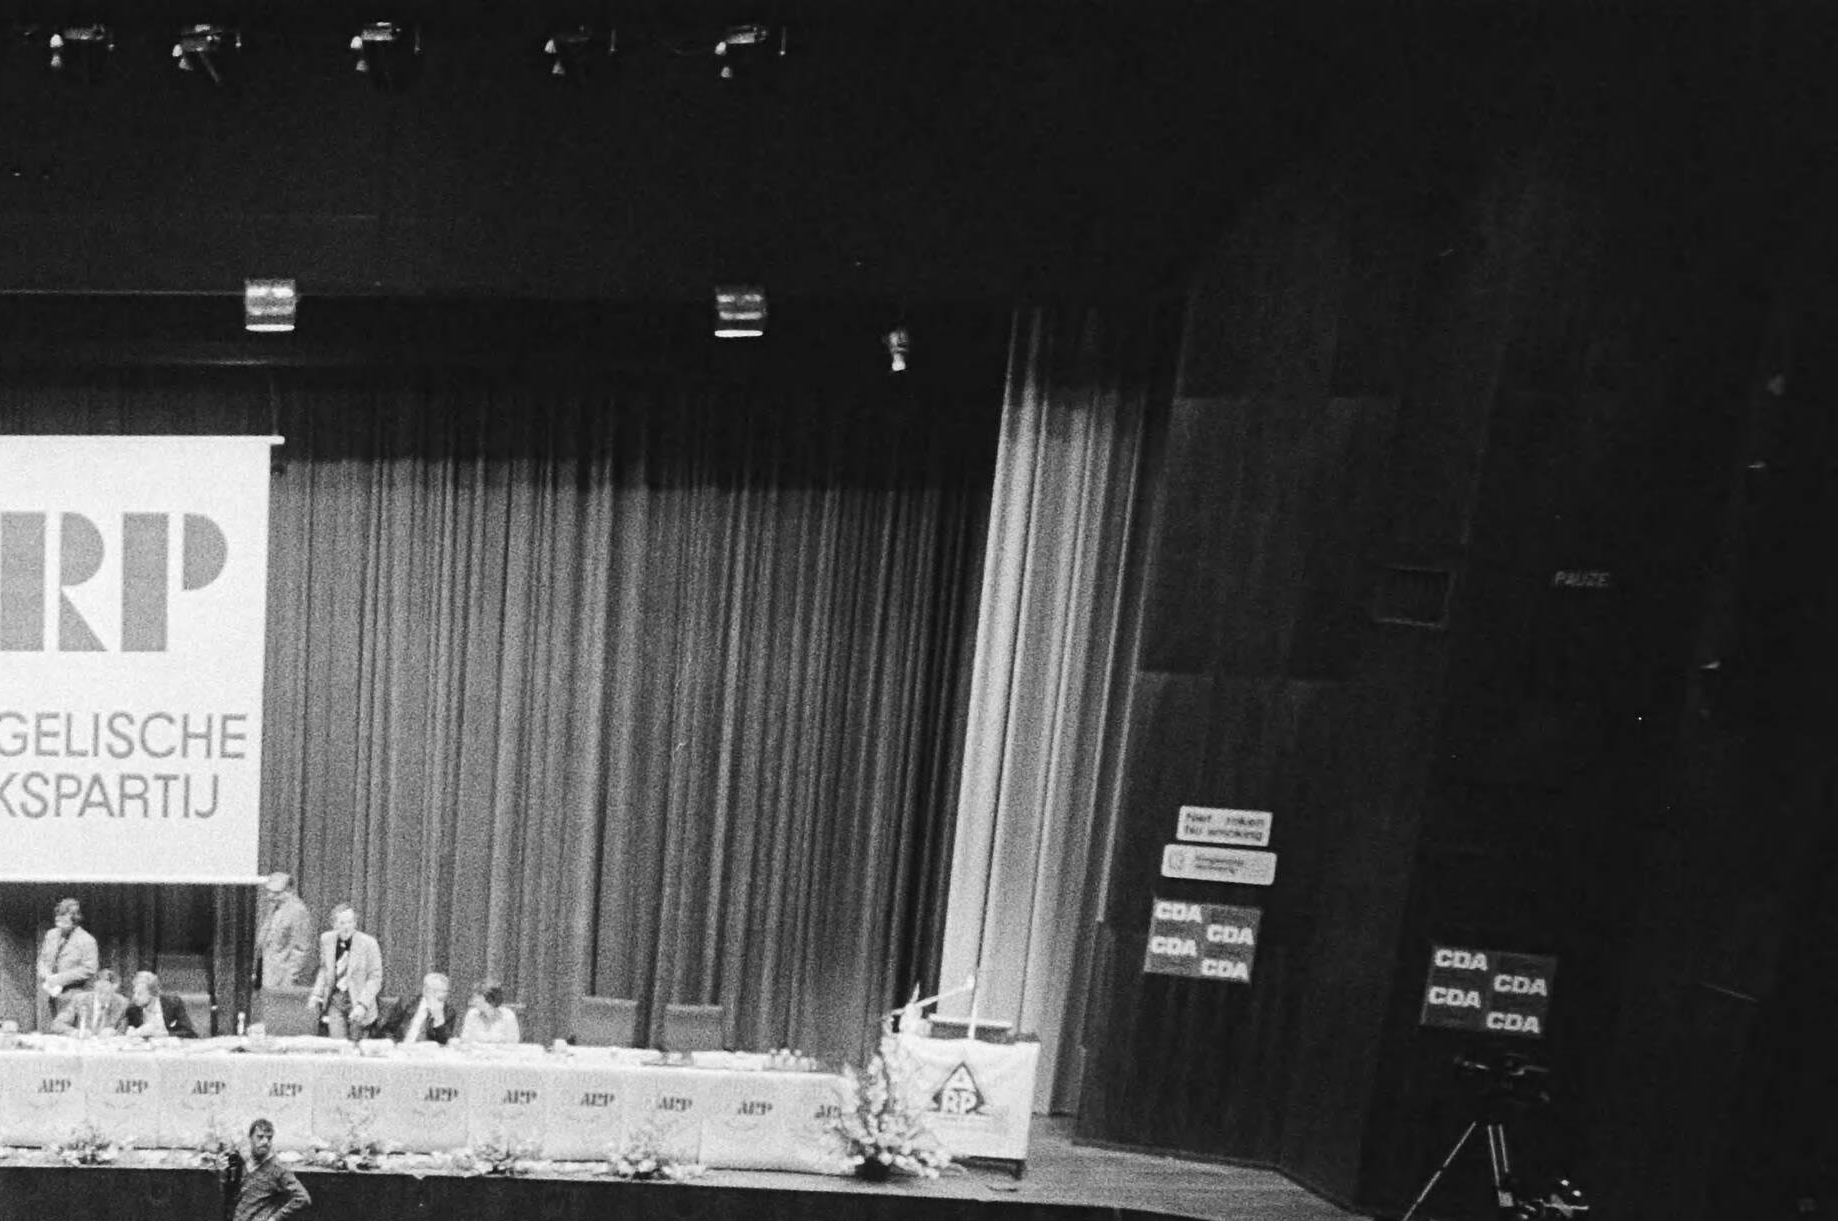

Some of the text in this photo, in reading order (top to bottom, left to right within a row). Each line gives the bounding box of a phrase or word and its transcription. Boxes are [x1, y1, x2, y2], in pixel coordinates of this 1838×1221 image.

[1154, 902, 1202, 922] CDA
[1206, 924, 1253, 945] CDA
[1150, 936, 1197, 956] CDA
[1201, 958, 1248, 979] CDA
[1434, 949, 1488, 971] CDA
[1493, 974, 1547, 996] CDA
[1428, 986, 1480, 1008] CDA
[1486, 1011, 1540, 1033] CDA
